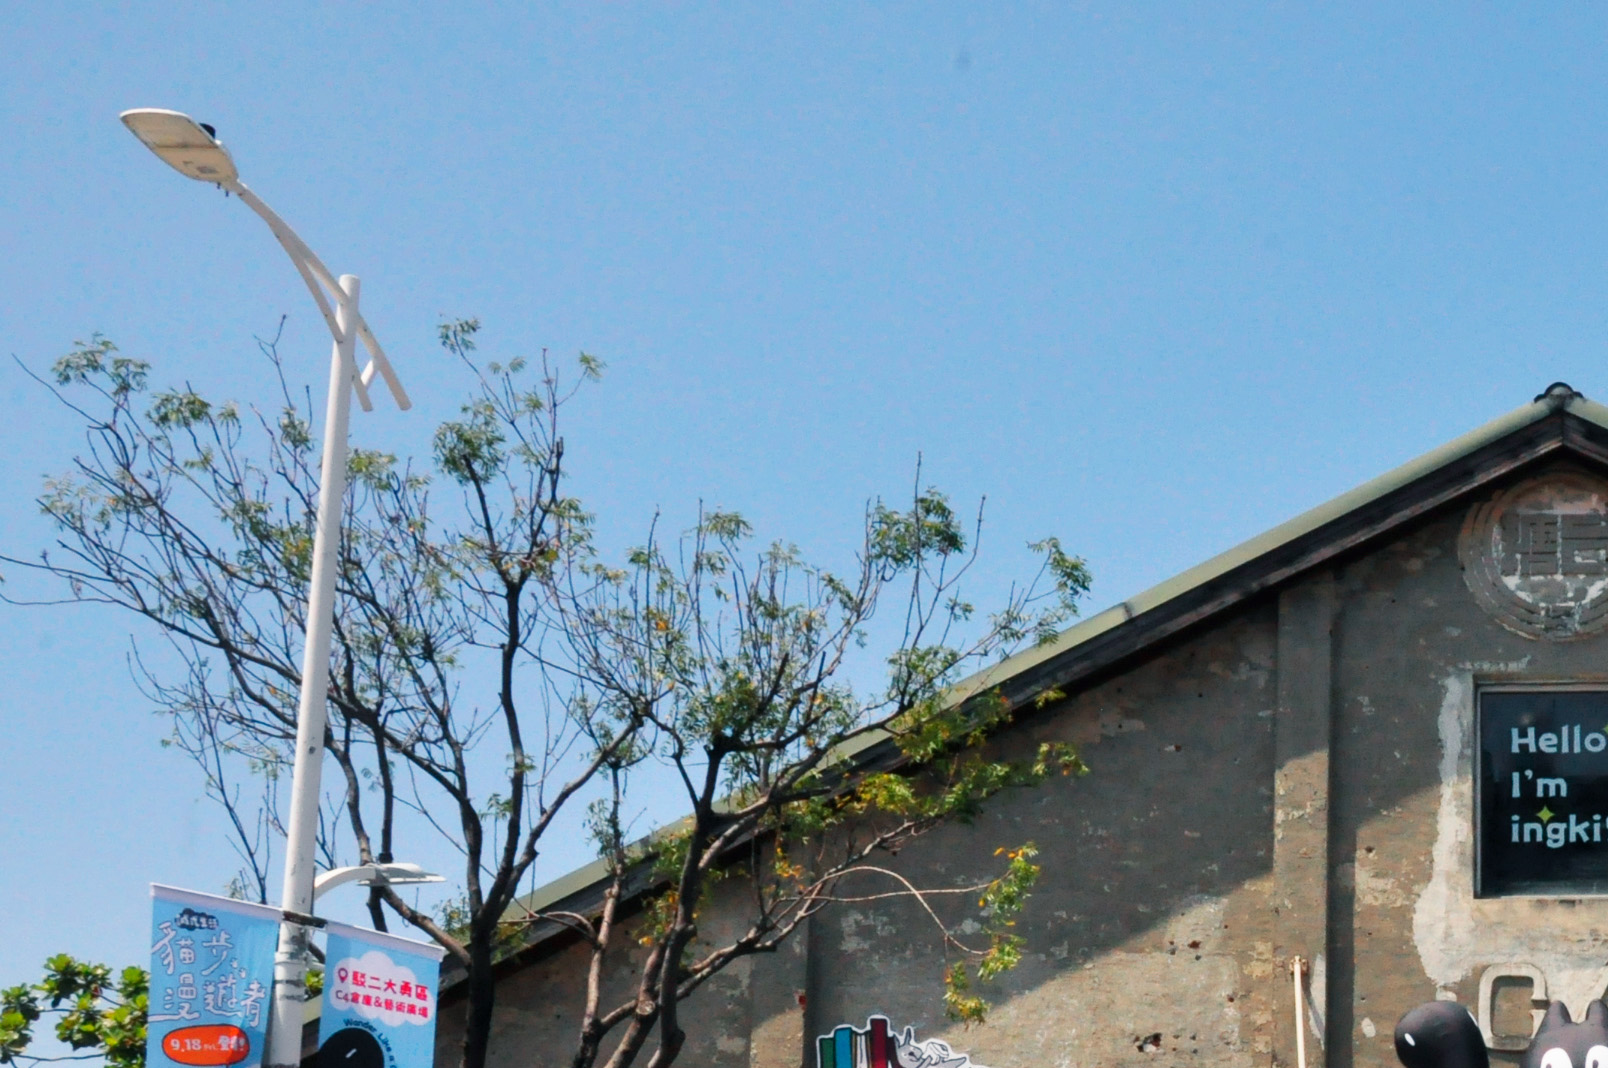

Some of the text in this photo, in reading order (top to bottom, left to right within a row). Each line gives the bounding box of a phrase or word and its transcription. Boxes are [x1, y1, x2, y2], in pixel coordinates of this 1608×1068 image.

[1510, 724, 1608, 754] Hello
[1511, 770, 1568, 798] I'm
[151, 921, 233, 976] 貓步
[147, 973, 266, 1028] 漫遊者
[352, 970, 428, 1001] 駁二大勇區
[170, 1038, 202, 1053] 9.18
[343, 1018, 377, 1033] Wander
[377, 1032, 392, 1052] Like
